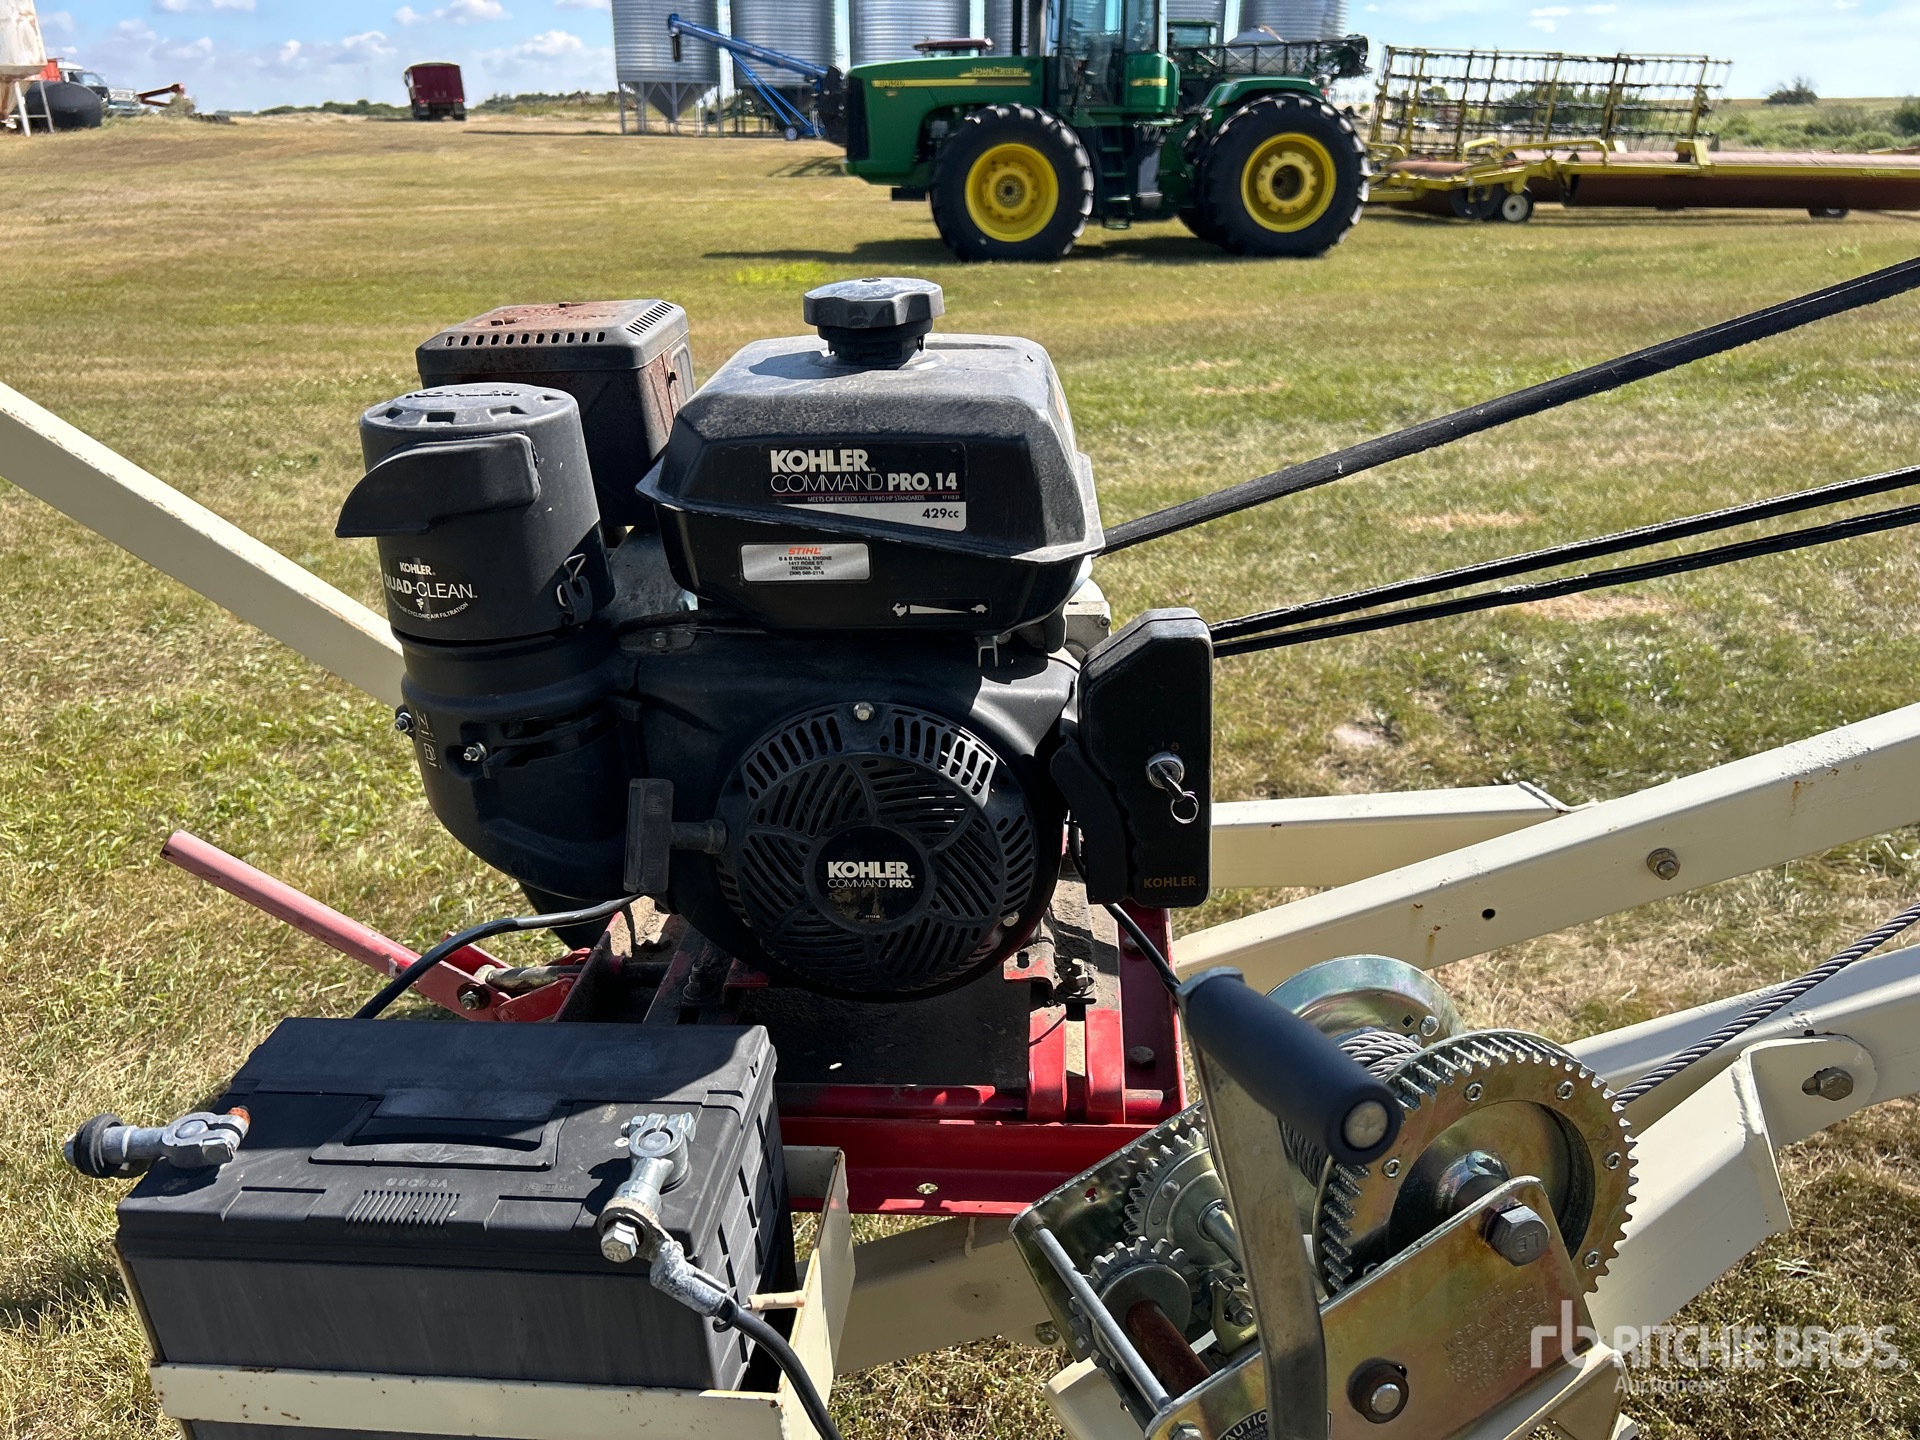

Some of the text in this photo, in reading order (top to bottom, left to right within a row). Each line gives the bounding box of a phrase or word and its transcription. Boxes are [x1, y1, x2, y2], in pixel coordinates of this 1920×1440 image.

[770, 449, 872, 473] KOHLER
[770, 472, 958, 493] COMMAND PRO 14
[921, 508, 959, 519] 429cc
[788, 547, 822, 555] STIHL
[399, 561, 433, 576] KOHLER
[384, 572, 474, 599] QUAD-CLEAN
[407, 609, 431, 619] CYCLONIC
[439, 601, 469, 618] FILTRATION
[827, 861, 911, 879] KOHLER
[827, 878, 912, 888] COMMAND PRO
[1143, 875, 1197, 889] KOHLER
[1225, 1411, 1267, 1440] AUTIO
